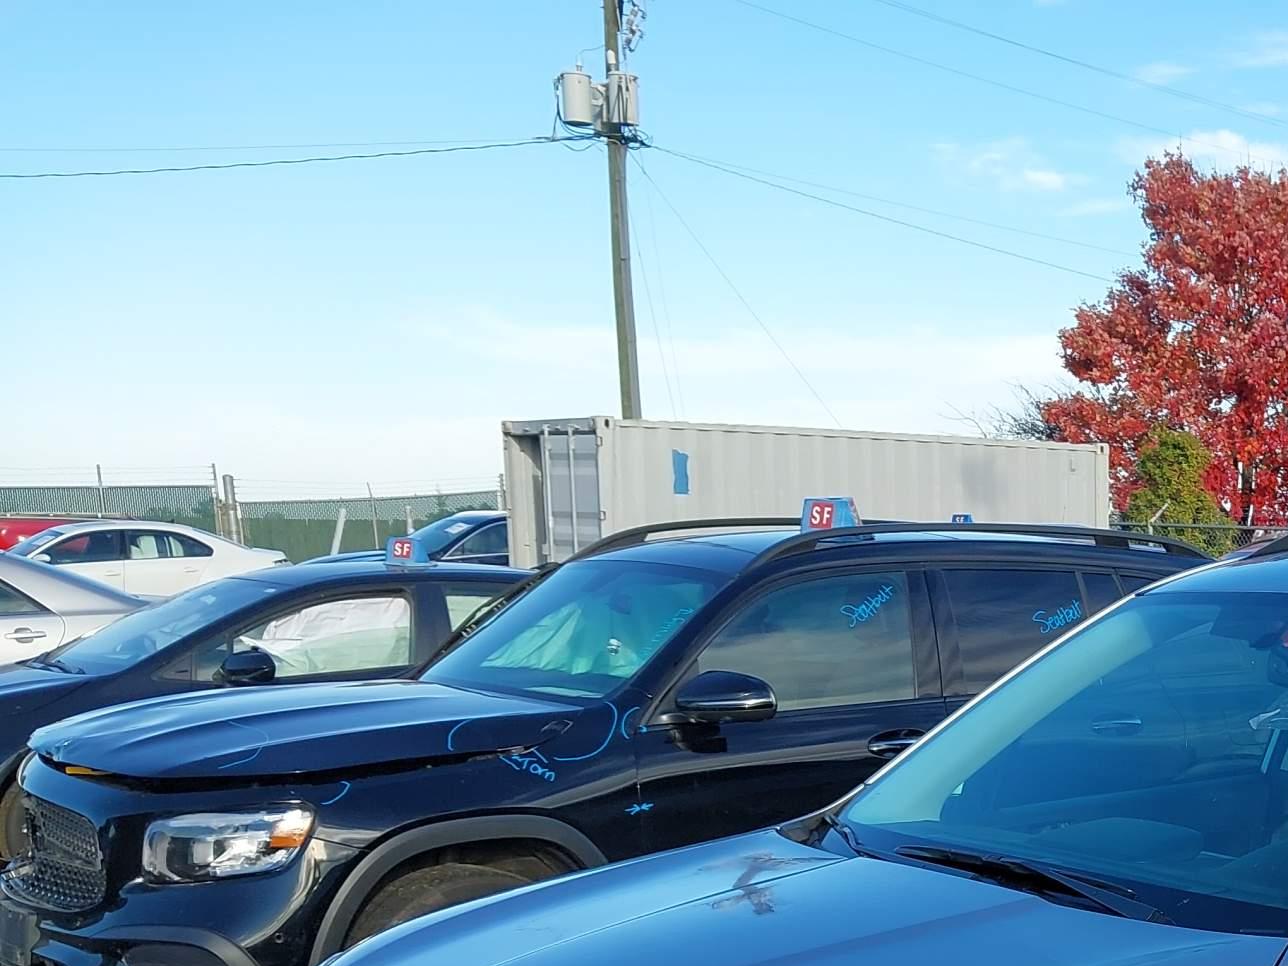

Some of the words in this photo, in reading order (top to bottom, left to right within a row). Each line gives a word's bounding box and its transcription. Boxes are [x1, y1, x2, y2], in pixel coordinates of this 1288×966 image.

[810, 505, 832, 525] SF
[394, 542, 411, 556] SF
[1032, 600, 1082, 634] Seatbelt
